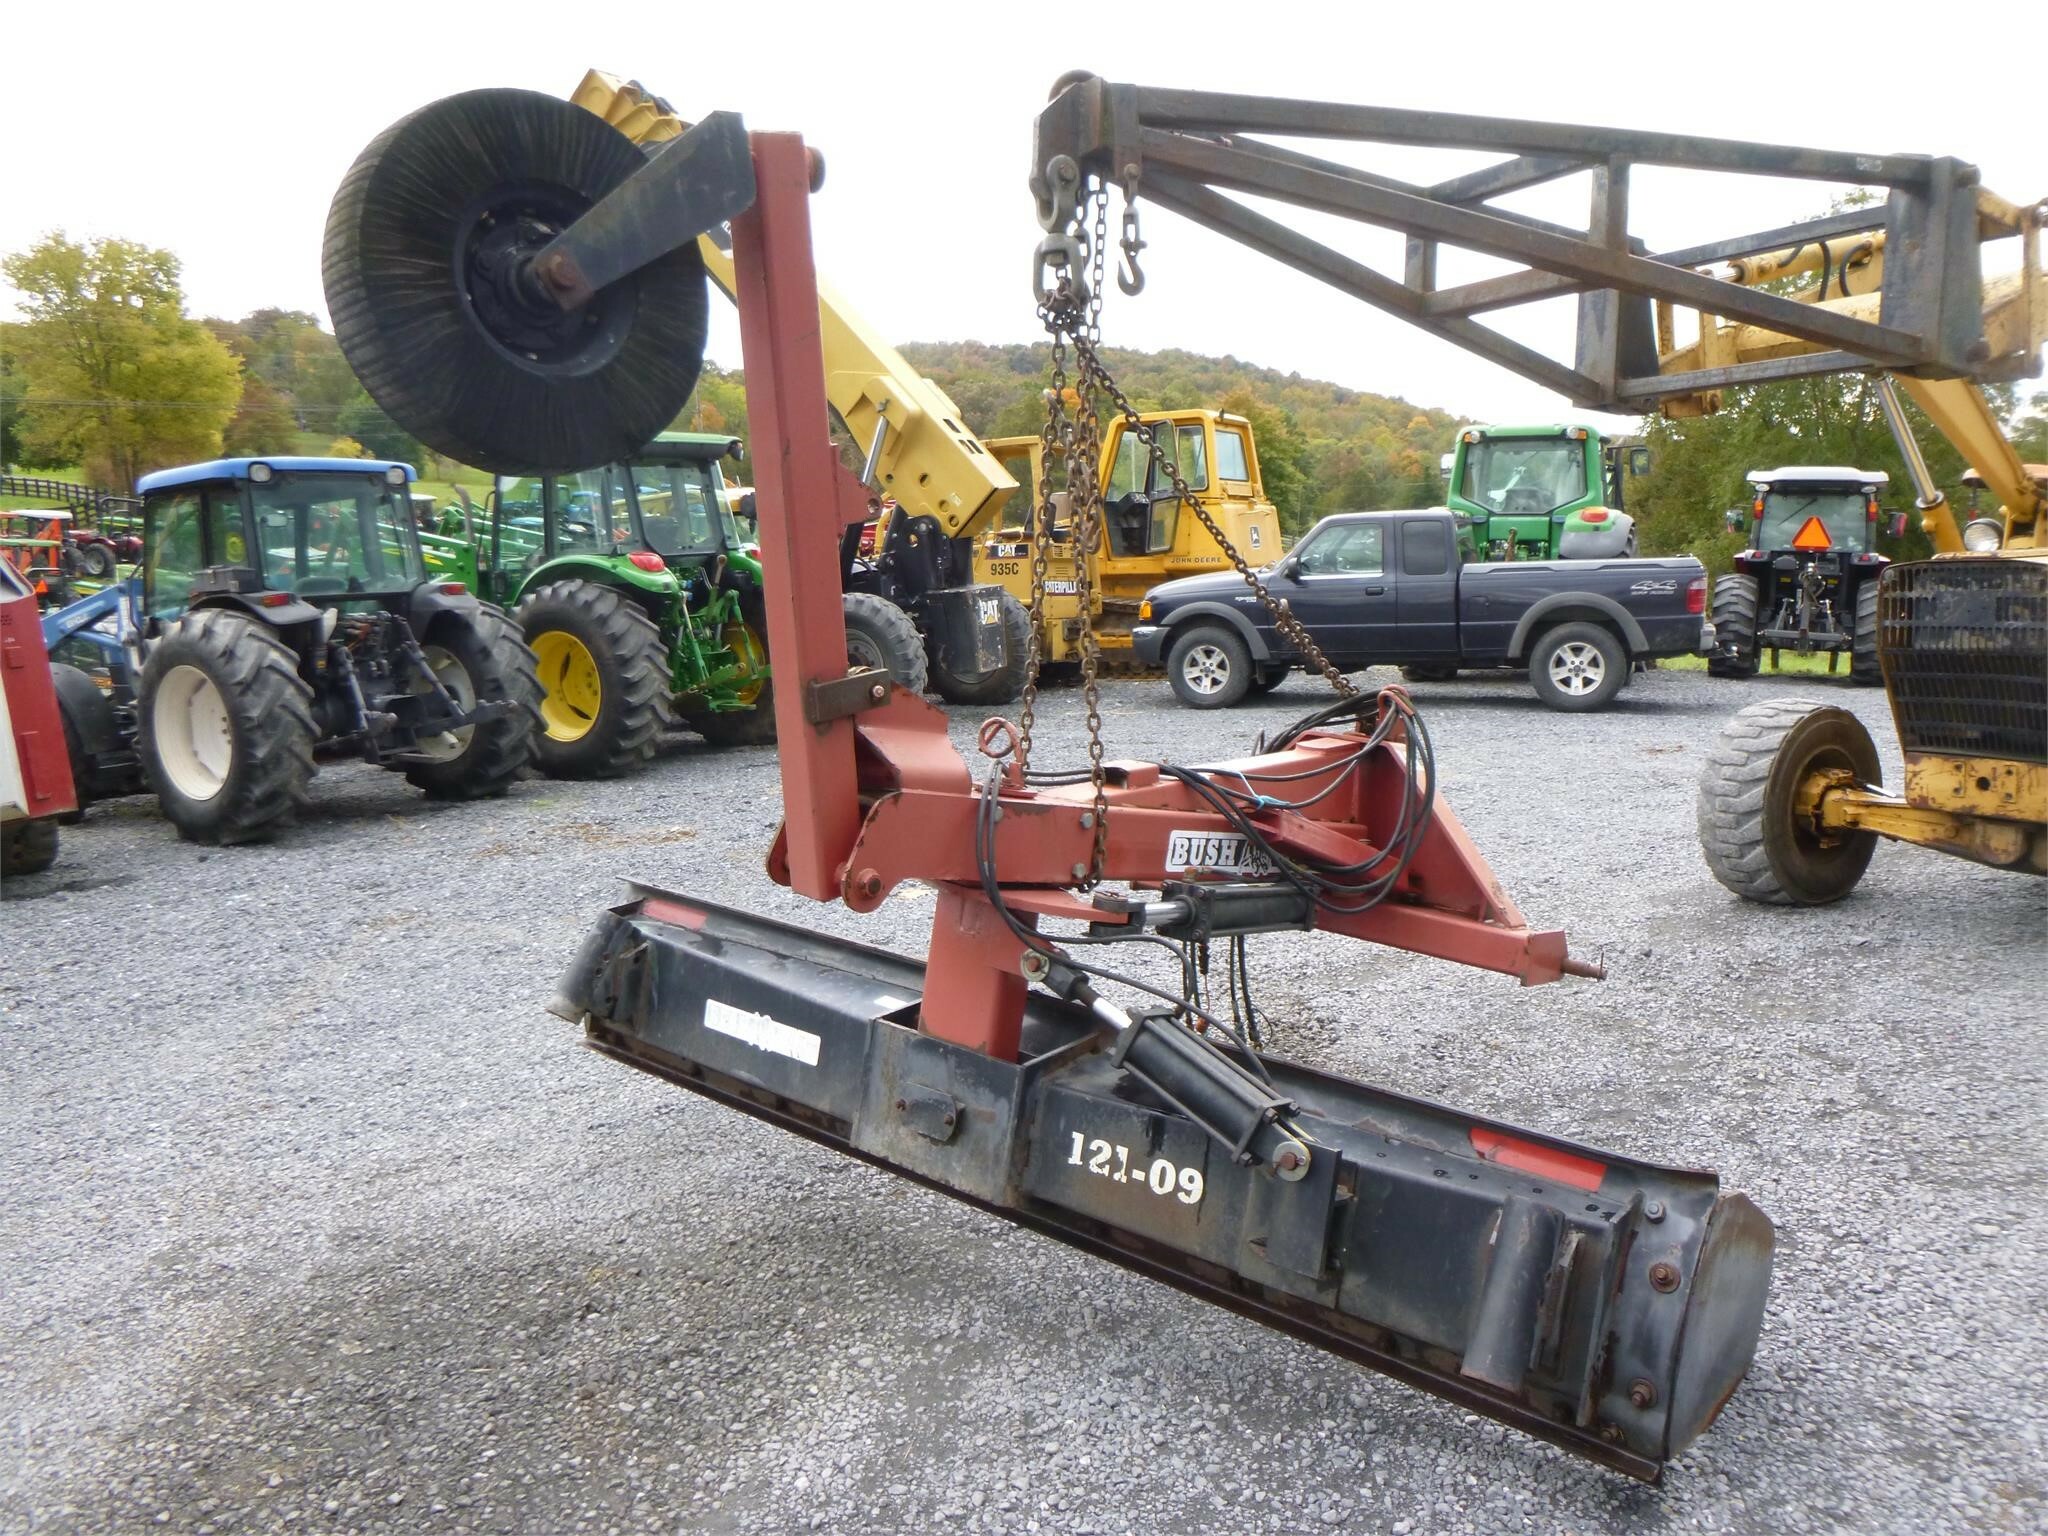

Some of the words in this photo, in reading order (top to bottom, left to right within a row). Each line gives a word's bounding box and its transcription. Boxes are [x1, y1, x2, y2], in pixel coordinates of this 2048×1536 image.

[997, 544, 1016, 557] CAT
[1170, 556, 1192, 564] JOHN
[1194, 556, 1222, 564] DEERE
[990, 562, 1019, 576] 935C
[979, 599, 999, 625] CAT
[1172, 838, 1238, 866] BUSH
[1067, 1131, 1204, 1205] 121-09
